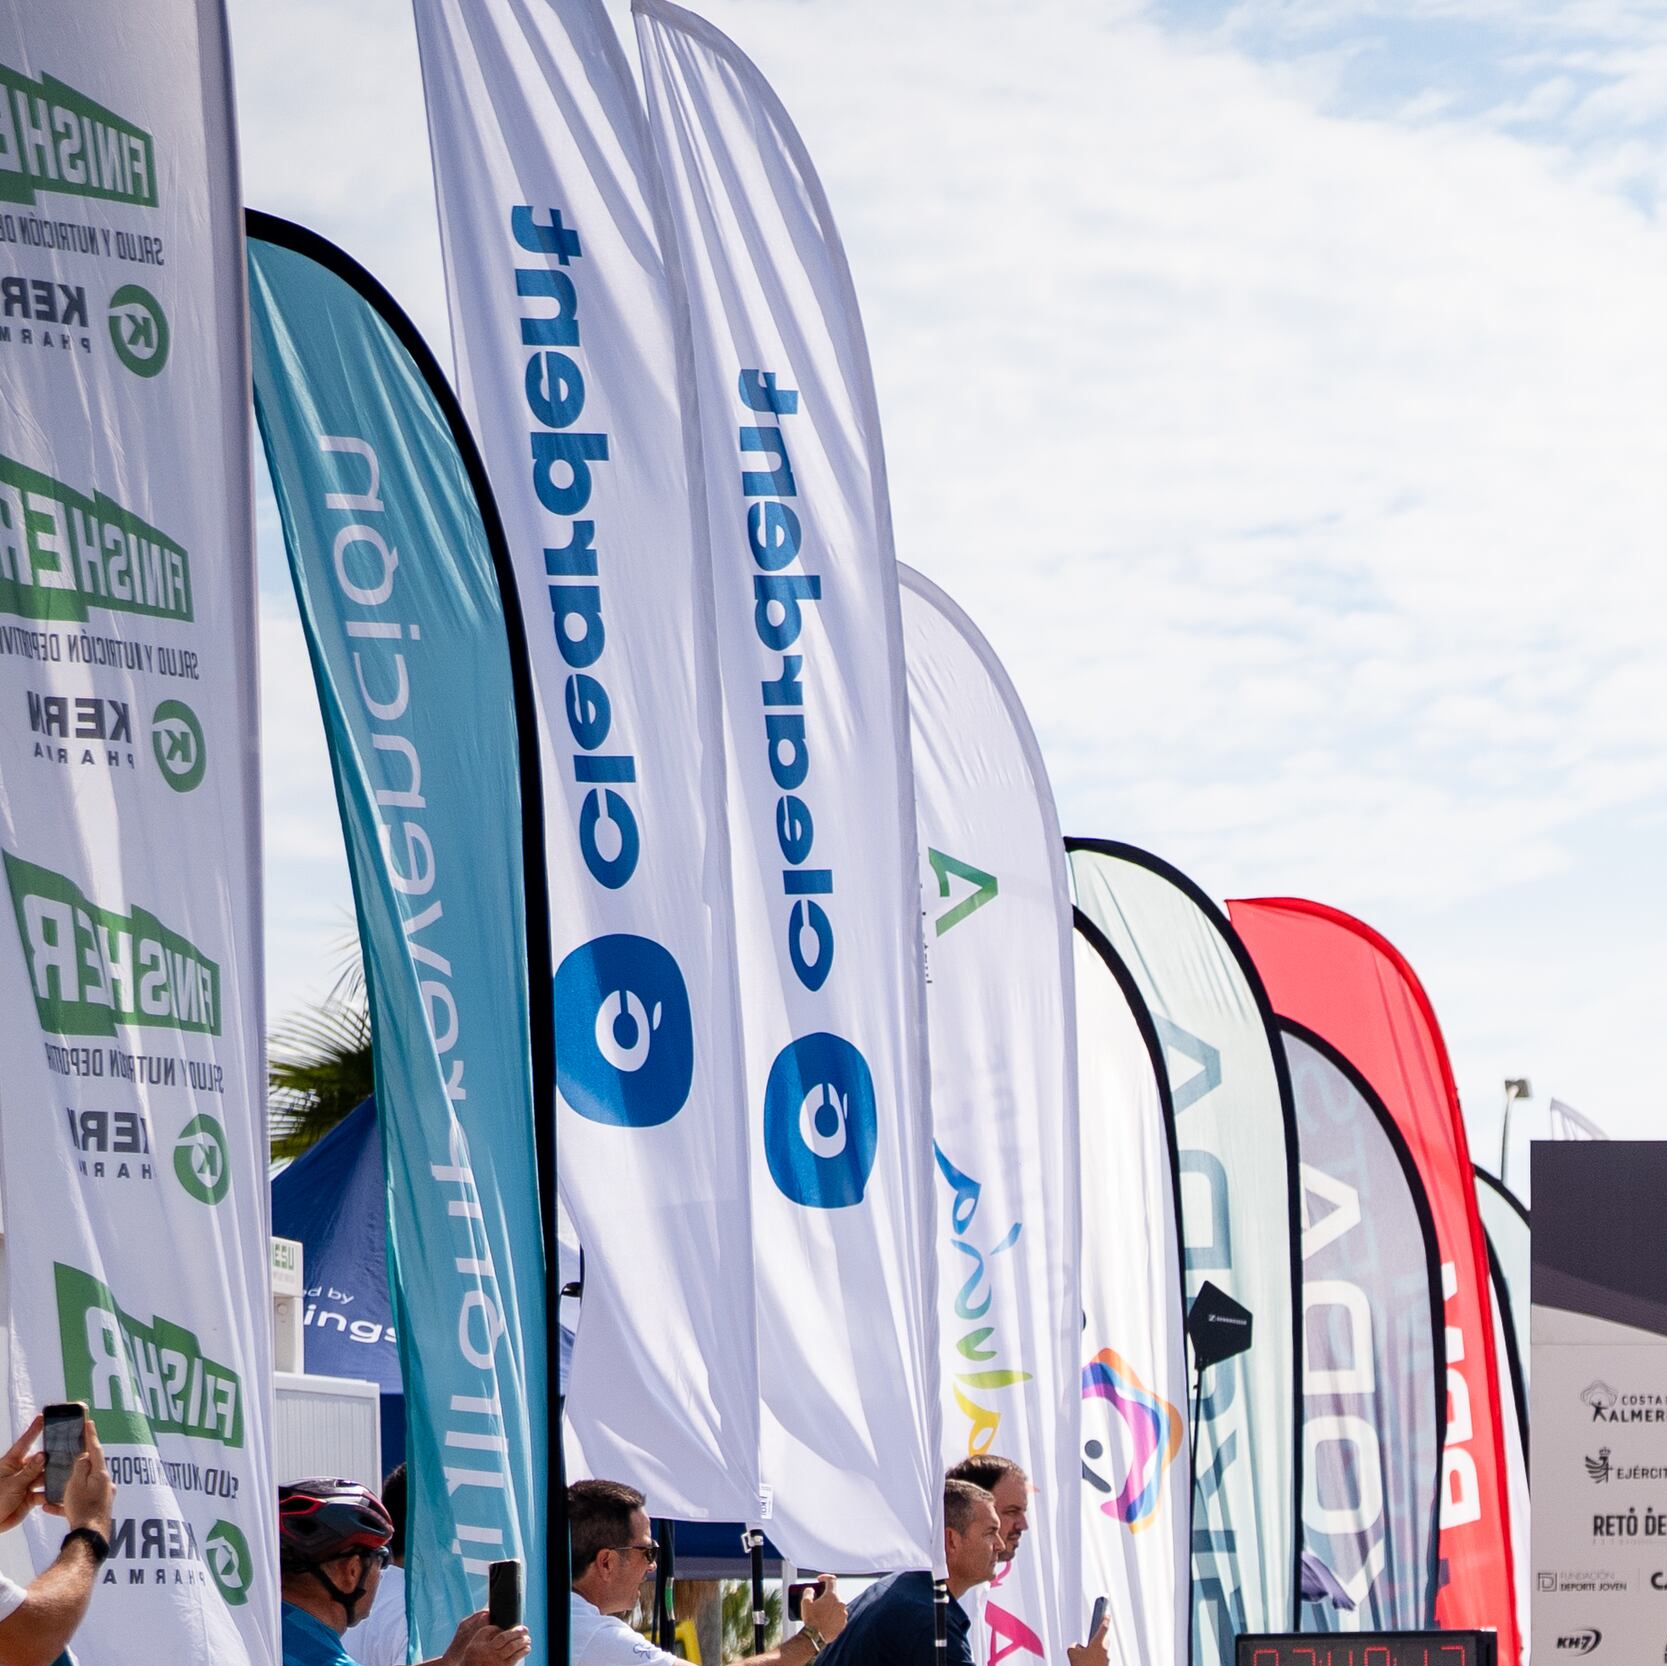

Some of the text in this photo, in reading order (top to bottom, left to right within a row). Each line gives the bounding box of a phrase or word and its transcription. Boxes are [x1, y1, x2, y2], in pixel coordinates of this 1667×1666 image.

[327, 1287, 355, 1305] by
[1621, 1395, 1664, 1405] COSTA
[1560, 1582, 1628, 1592] DEPORTE JOVEN
